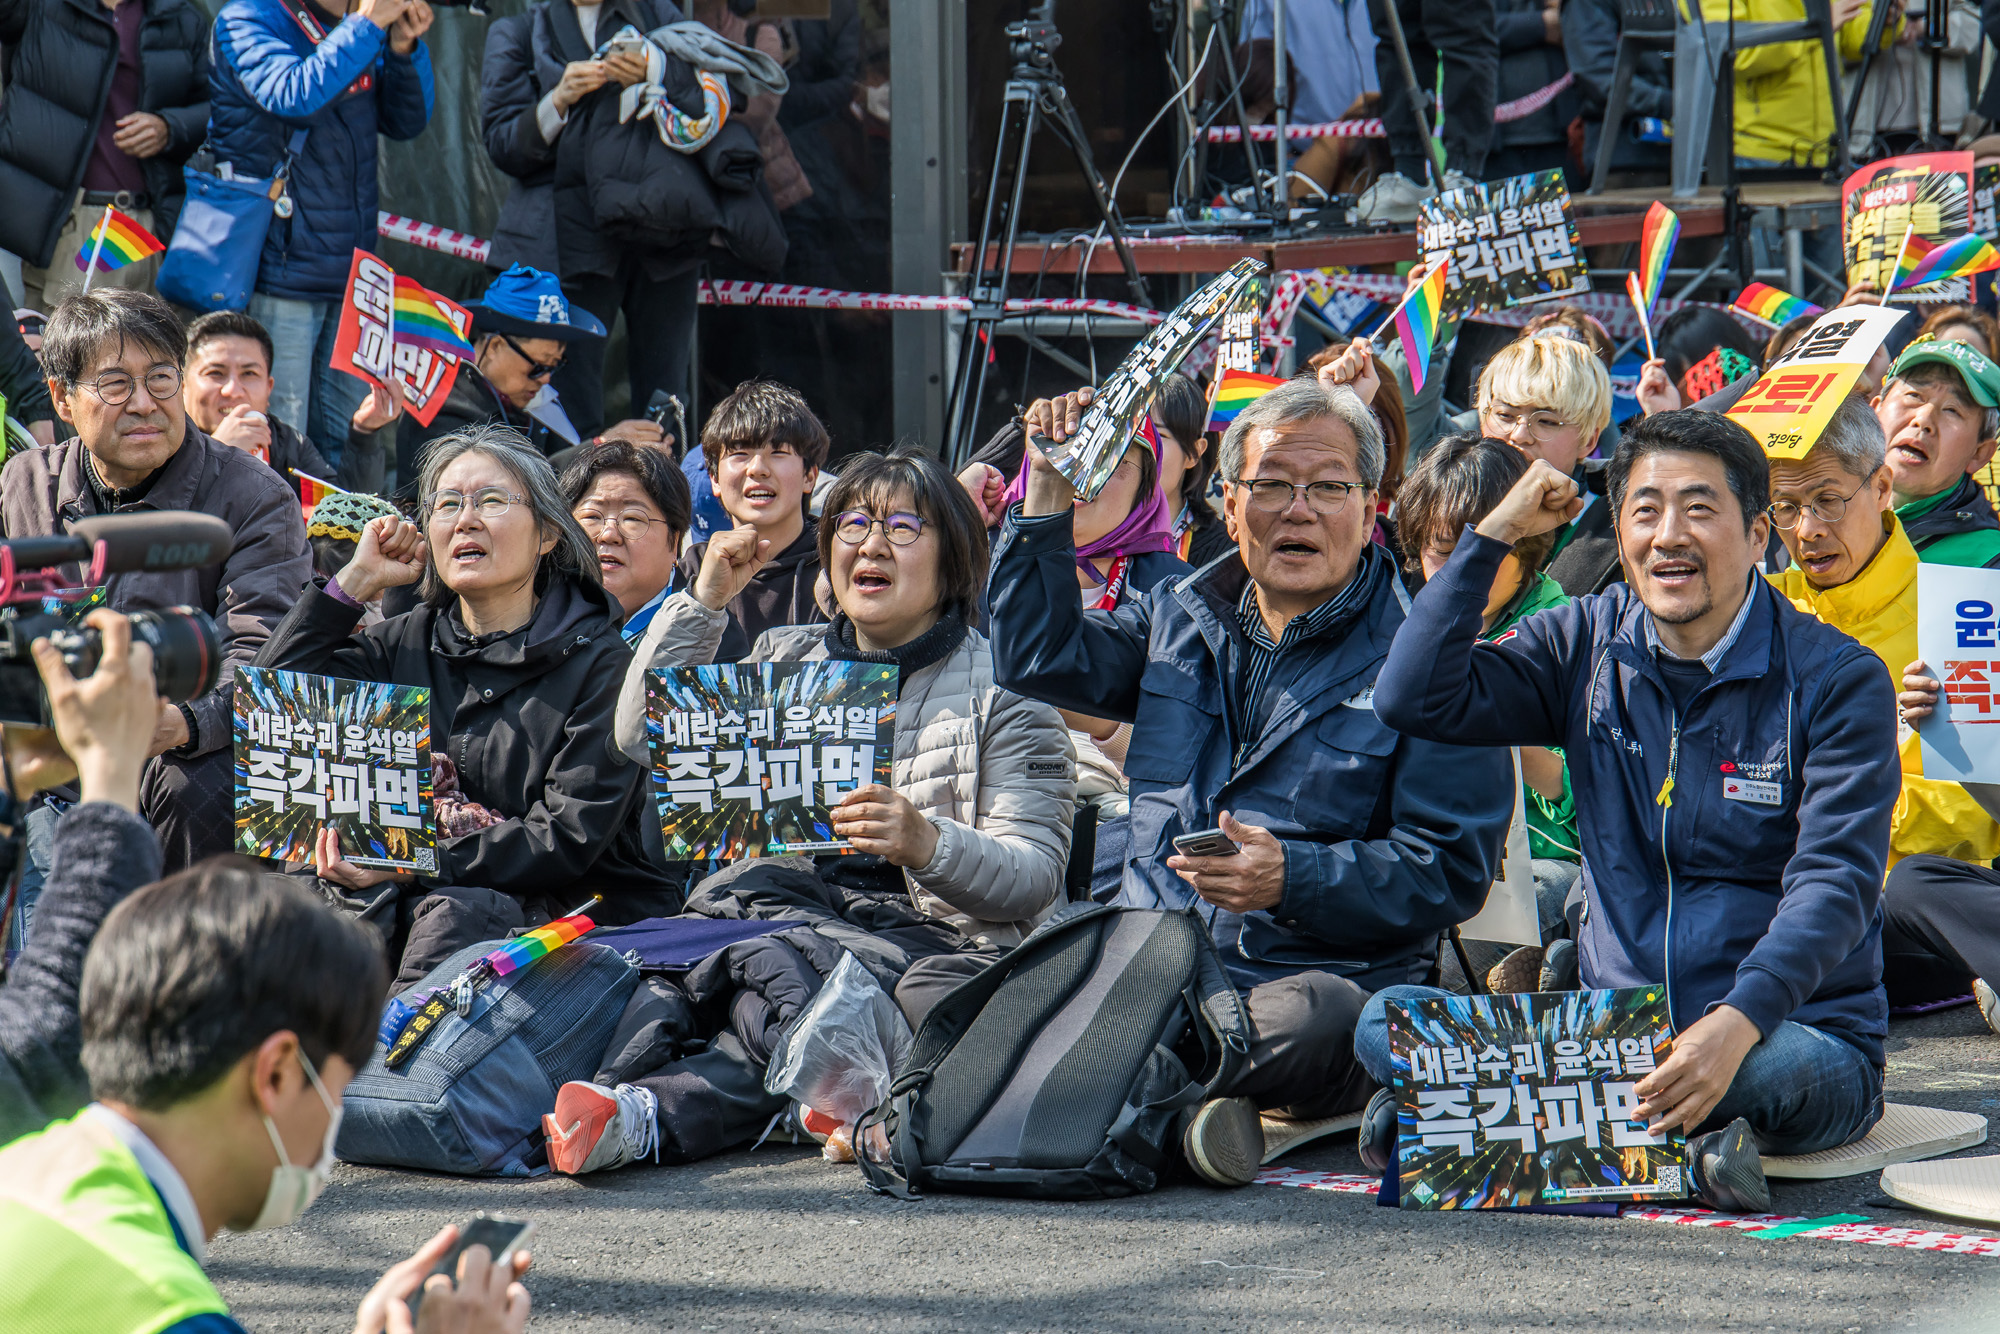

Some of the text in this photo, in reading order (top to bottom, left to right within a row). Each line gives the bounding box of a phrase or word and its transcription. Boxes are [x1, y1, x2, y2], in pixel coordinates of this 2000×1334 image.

[1424, 199, 1566, 250] 내란수괴 윤석열
[1767, 432, 1803, 449] 정의당
[1955, 600, 2000, 648] 윤
[247, 712, 337, 755] 내란수괴
[343, 724, 417, 765] 윤석열
[663, 705, 877, 746] 내란수괴 윤석열
[247, 749, 422, 829] 즉각파면
[667, 744, 875, 813] 즉각파면
[1028, 761, 1066, 771] Discovery
[1410, 1035, 1657, 1085] 내란수괴 윤석열
[1416, 1080, 1668, 1158] 즉각파면
